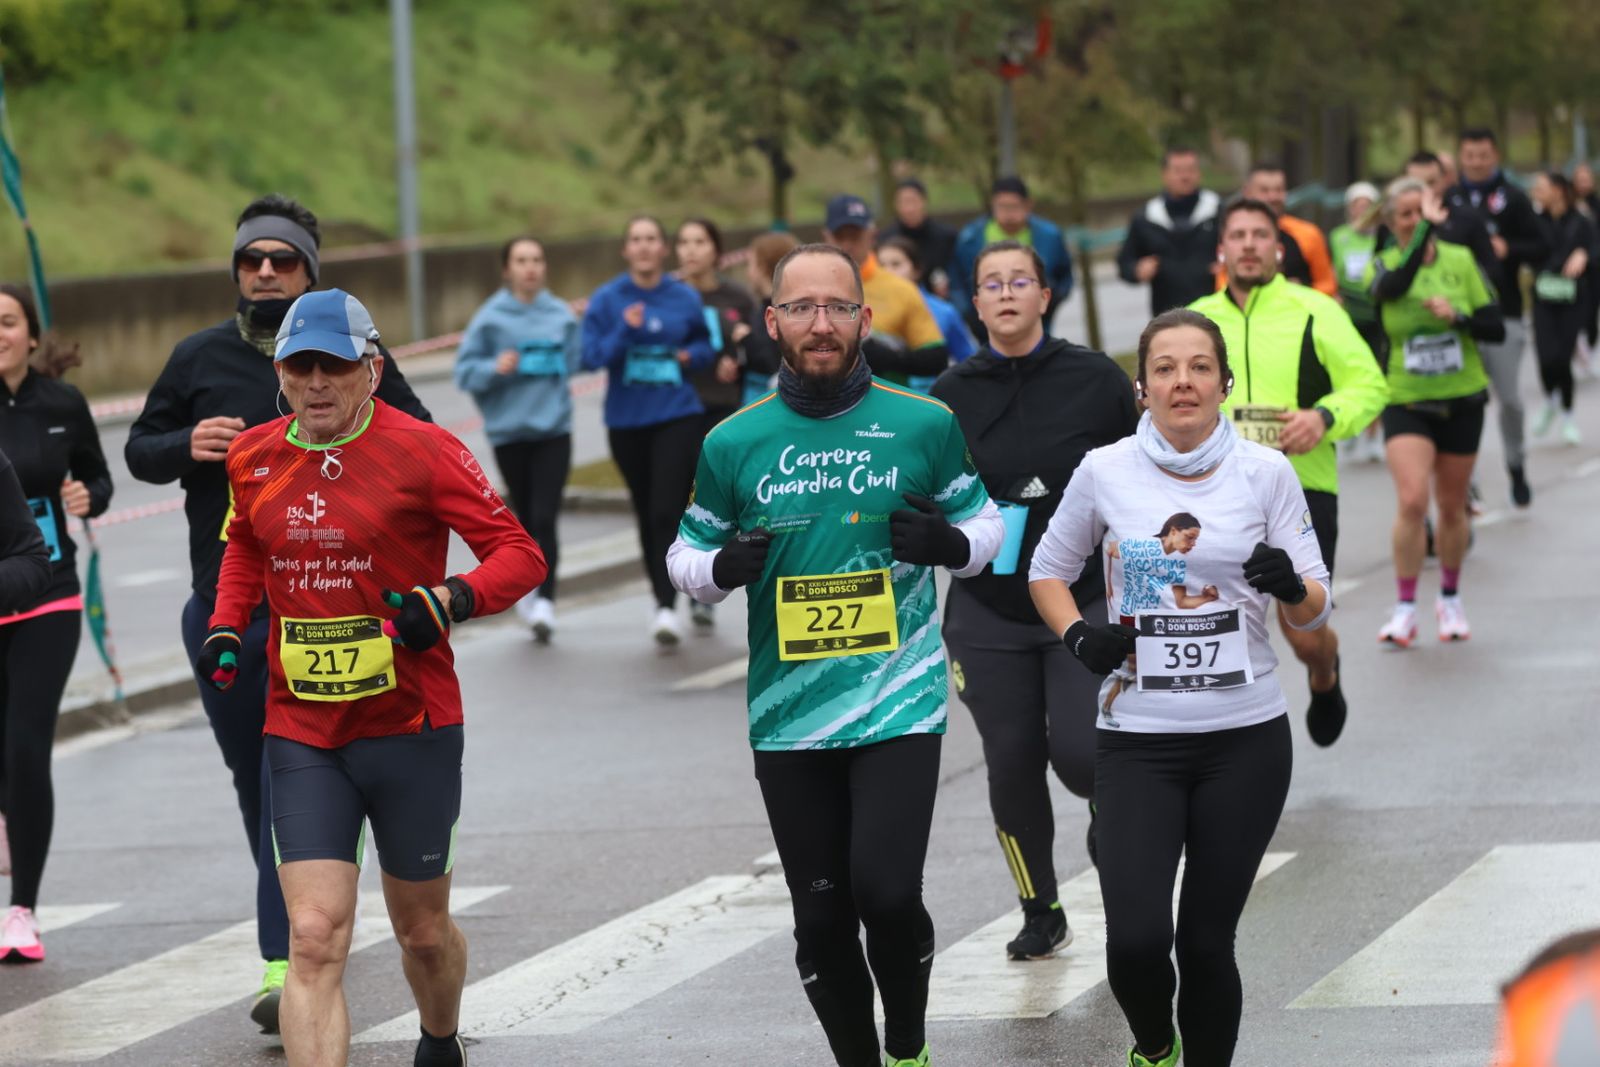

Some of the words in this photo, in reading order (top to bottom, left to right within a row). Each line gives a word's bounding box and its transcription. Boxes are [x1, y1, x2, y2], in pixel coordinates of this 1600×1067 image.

[778, 444, 871, 475] Carrera
[756, 468, 842, 504] Guardia
[848, 464, 898, 495] Civil
[287, 525, 309, 543] colegio
[319, 525, 345, 540] médicos
[270, 555, 300, 572] Juntos
[305, 560, 321, 574] por
[326, 556, 337, 572] la
[341, 555, 373, 572] salud
[288, 577, 294, 592] y
[299, 574, 308, 590] el
[312, 573, 353, 592] deporte
[808, 587, 827, 595] DON
[829, 584, 858, 594] BOSCO
[344, 620, 369, 629] POPULAR
[806, 603, 863, 632] 227
[1168, 623, 1186, 631] DON
[1187, 621, 1216, 631] BOSCO
[1207, 613, 1229, 622] POPULAR
[306, 630, 324, 638] DON
[325, 629, 353, 638] BOSCO
[305, 647, 360, 675] 217
[1164, 641, 1220, 670] 397
